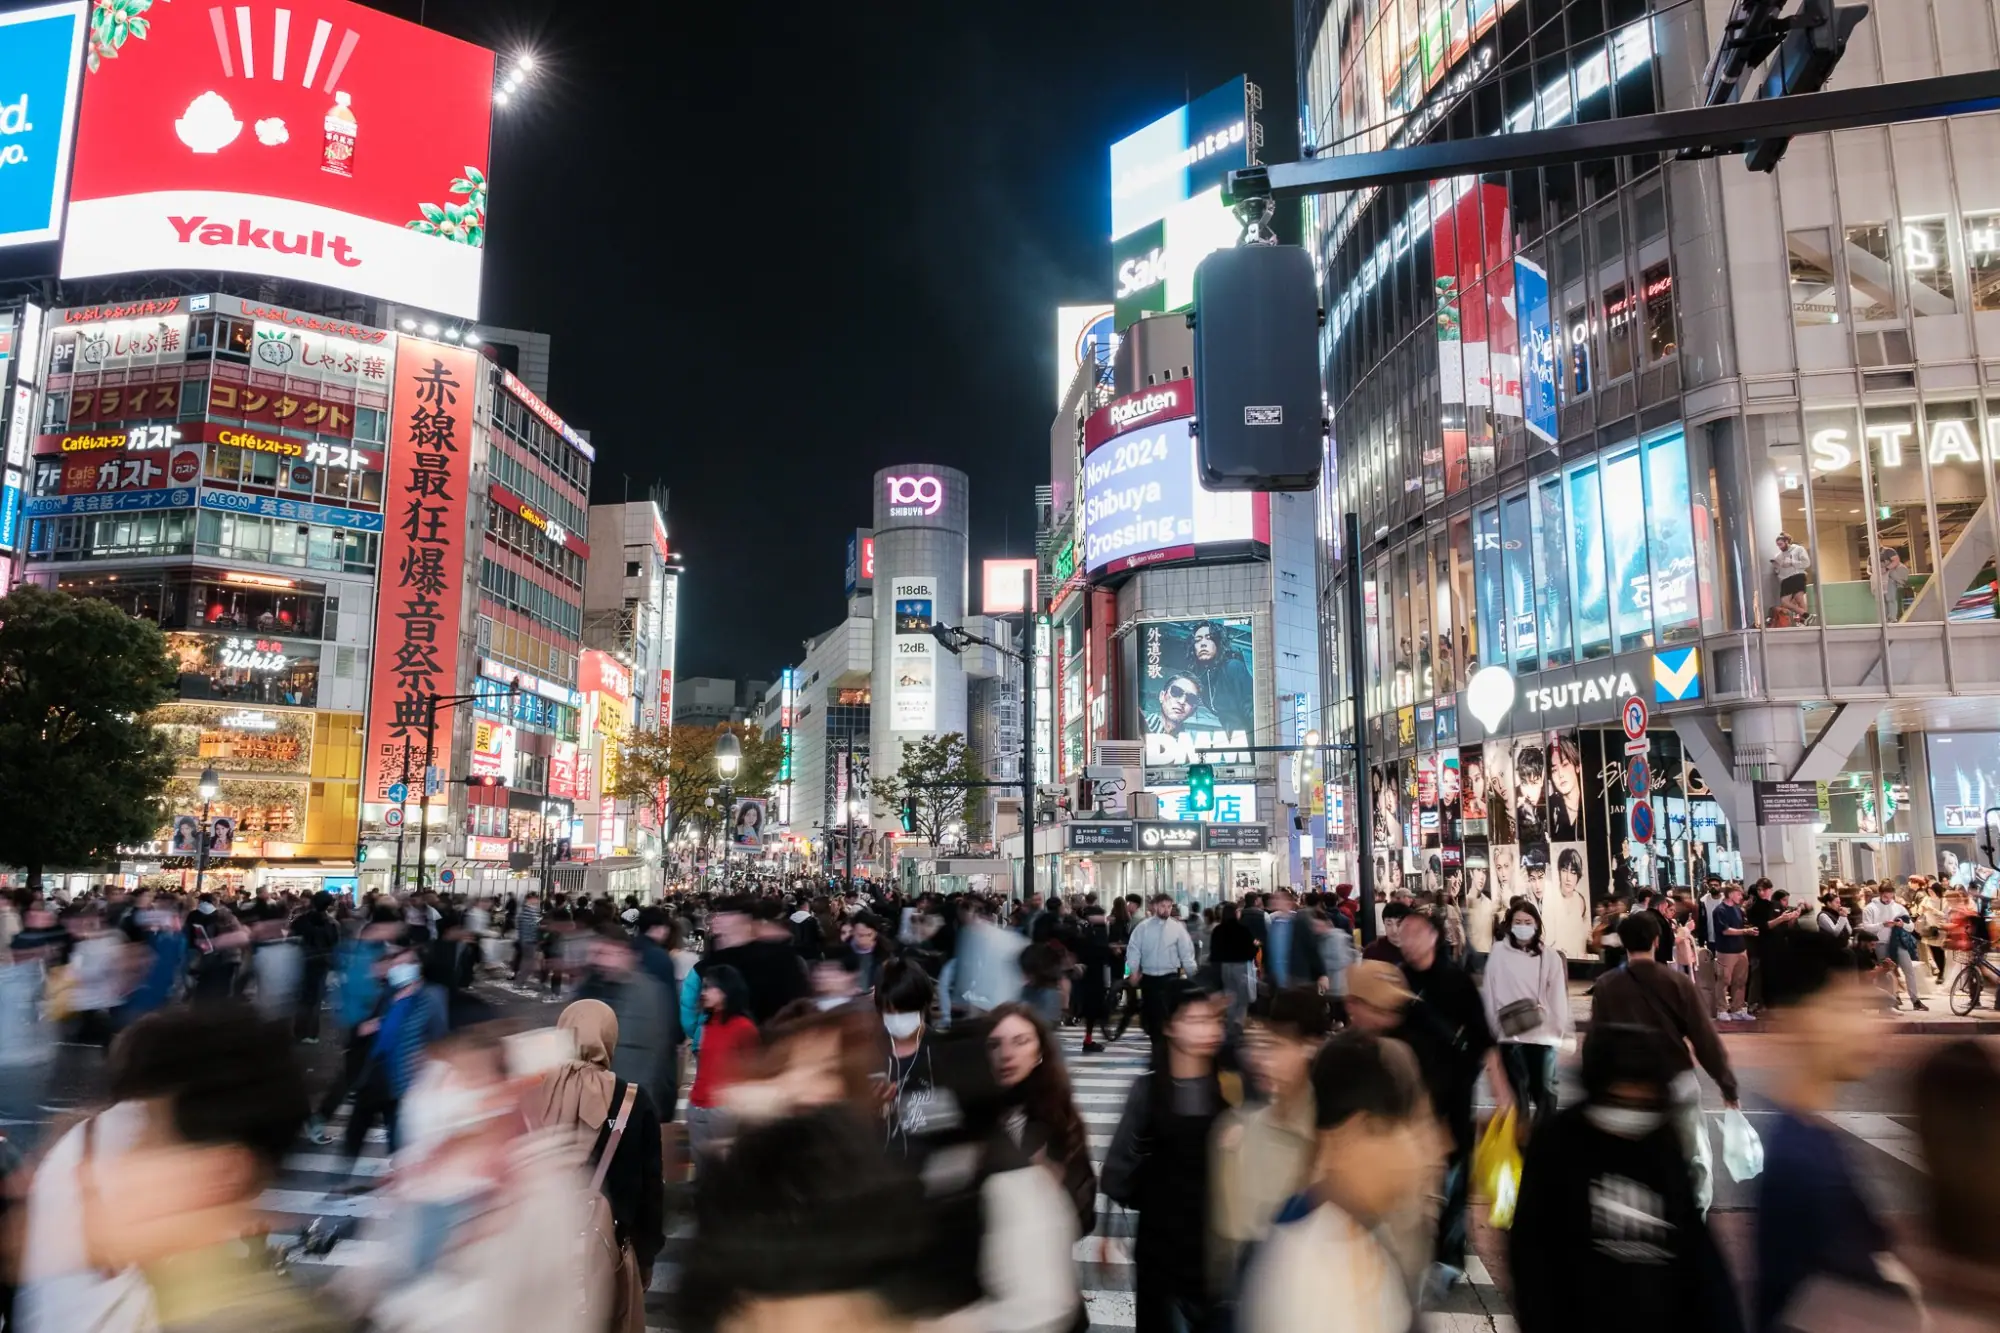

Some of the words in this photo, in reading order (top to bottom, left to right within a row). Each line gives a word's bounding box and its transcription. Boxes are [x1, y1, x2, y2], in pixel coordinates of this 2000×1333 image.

[167, 216, 362, 267] Yakult
[64, 298, 180, 323] しゃぶしゃぶバイキング
[241, 299, 387, 344] しゃぶしゃぶバイキング
[54, 344, 74, 359] 9F
[115, 329, 180, 355] しゃぶ葉
[302, 342, 385, 379] しゃぶ葉
[73, 386, 176, 417] プライス
[212, 384, 350, 428] コンタクト
[1110, 390, 1177, 424] Rakuten
[128, 425, 182, 450] ガスト
[305, 442, 369, 470] ガスト
[1087, 434, 1168, 490] Nov.2024
[37, 469, 61, 487] 7F
[97, 459, 162, 490] ガスト
[32, 501, 61, 511] AEON
[72, 492, 166, 511] 英会話イーオン
[206, 492, 250, 508] AEON
[261, 499, 379, 526] 英会話イーオン
[887, 476, 942, 515] 109
[890, 507, 923, 516] SHIBUYA
[1087, 480, 1161, 526] Shibuya
[386, 358, 461, 738] 赤線最狂爆音祭典
[1087, 515, 1175, 560] Crossing
[1147, 627, 1163, 679] 外道の歌
[1526, 672, 1637, 712] TSUTAYA
[1145, 730, 1252, 765] DMM
